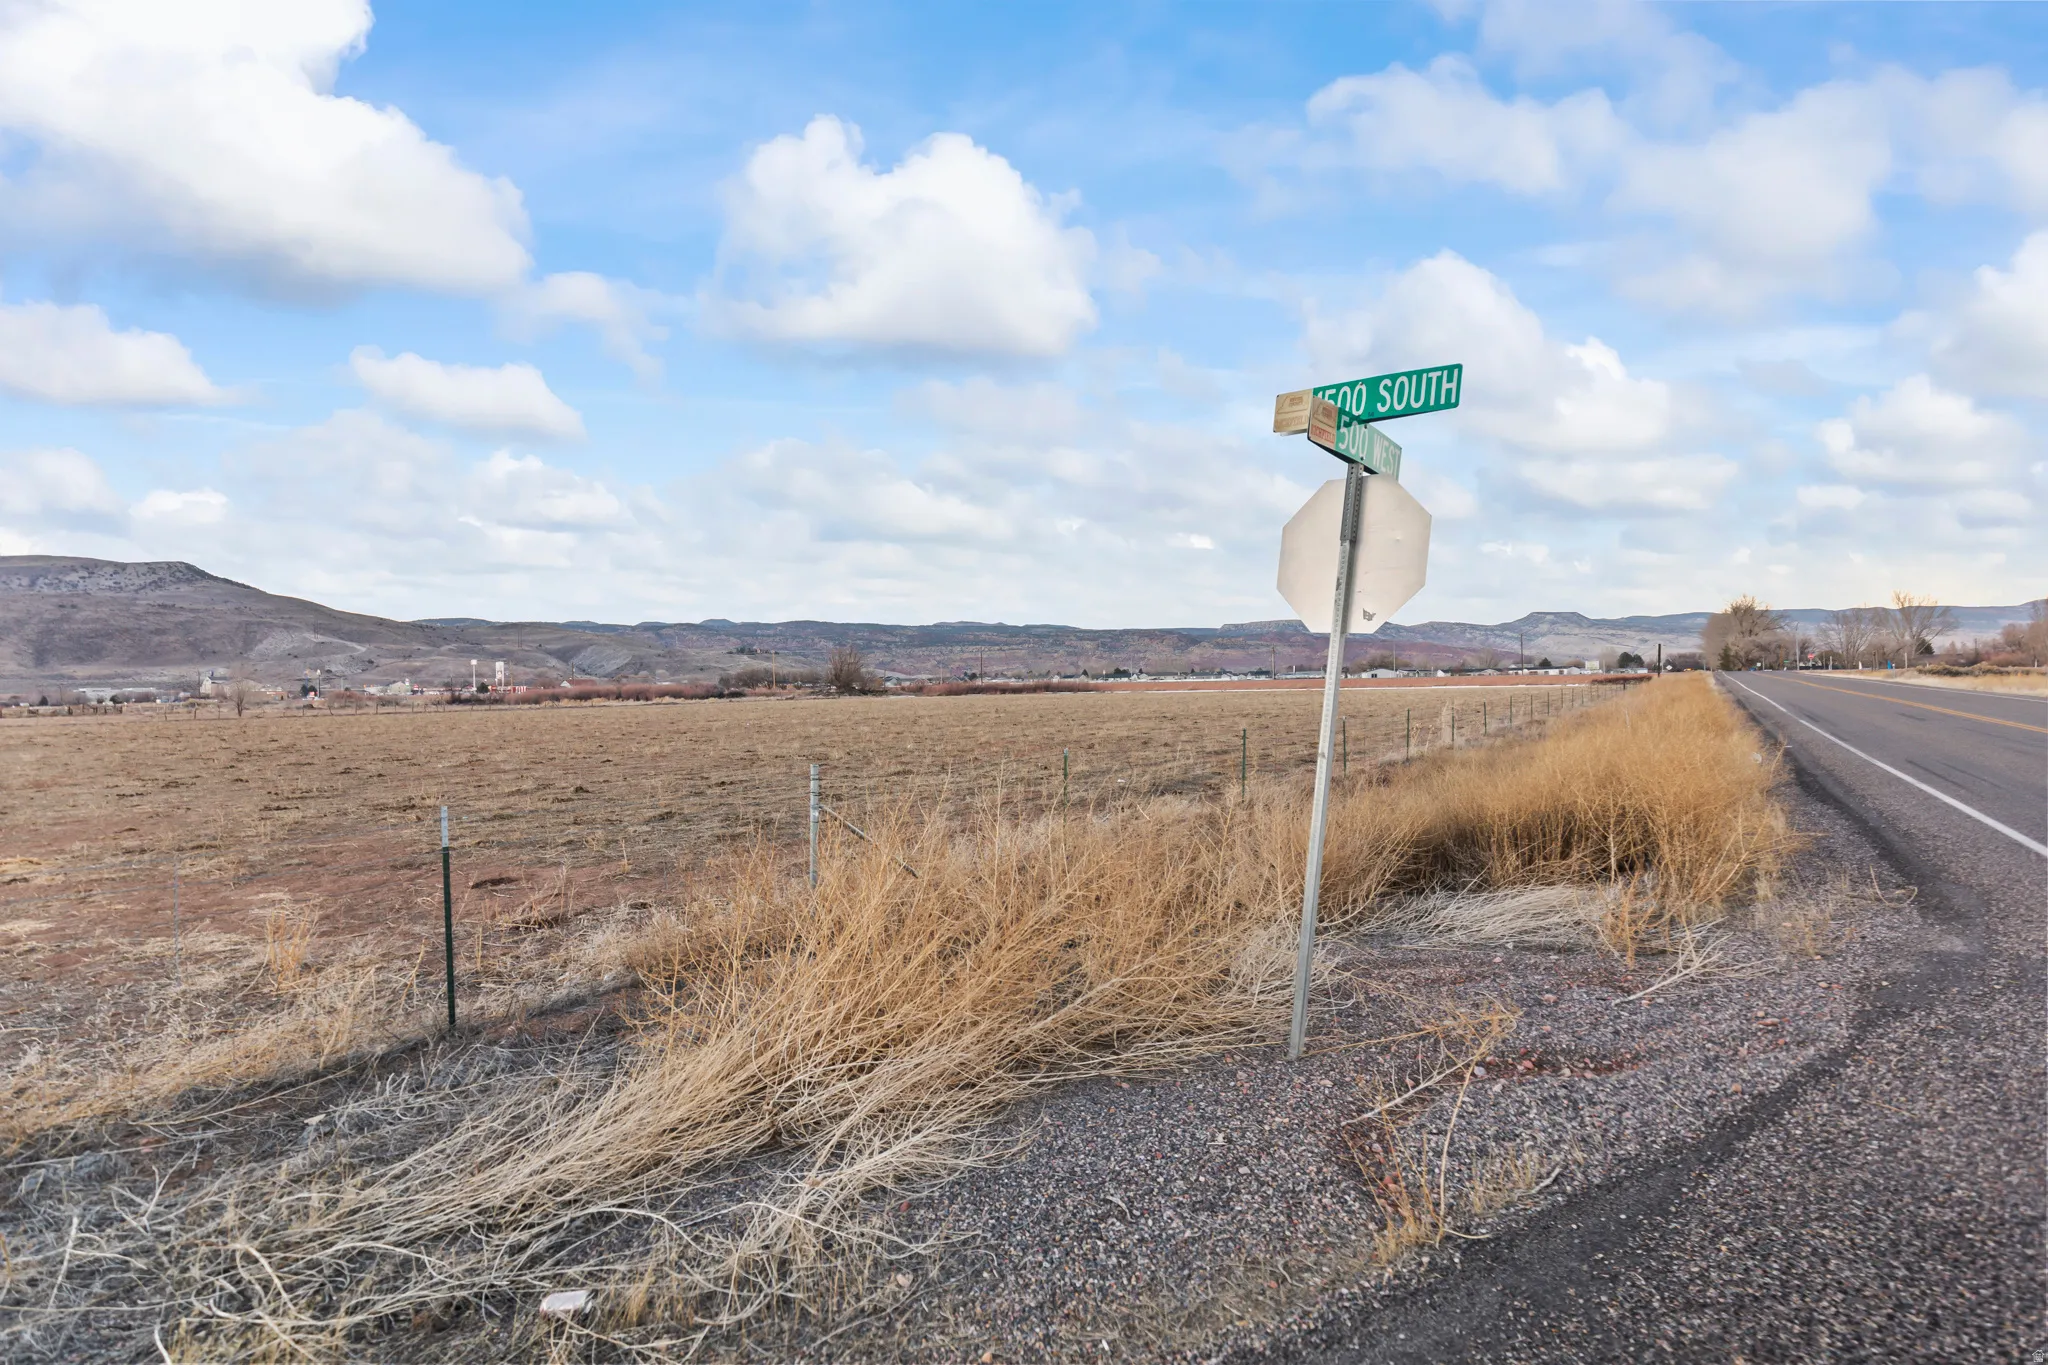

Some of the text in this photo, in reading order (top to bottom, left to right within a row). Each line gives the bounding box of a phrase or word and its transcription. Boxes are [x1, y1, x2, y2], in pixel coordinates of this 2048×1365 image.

[1317, 368, 1459, 416] 500 SOUTH
[1338, 414, 1369, 460] 500
[1373, 432, 1400, 478] WEST
